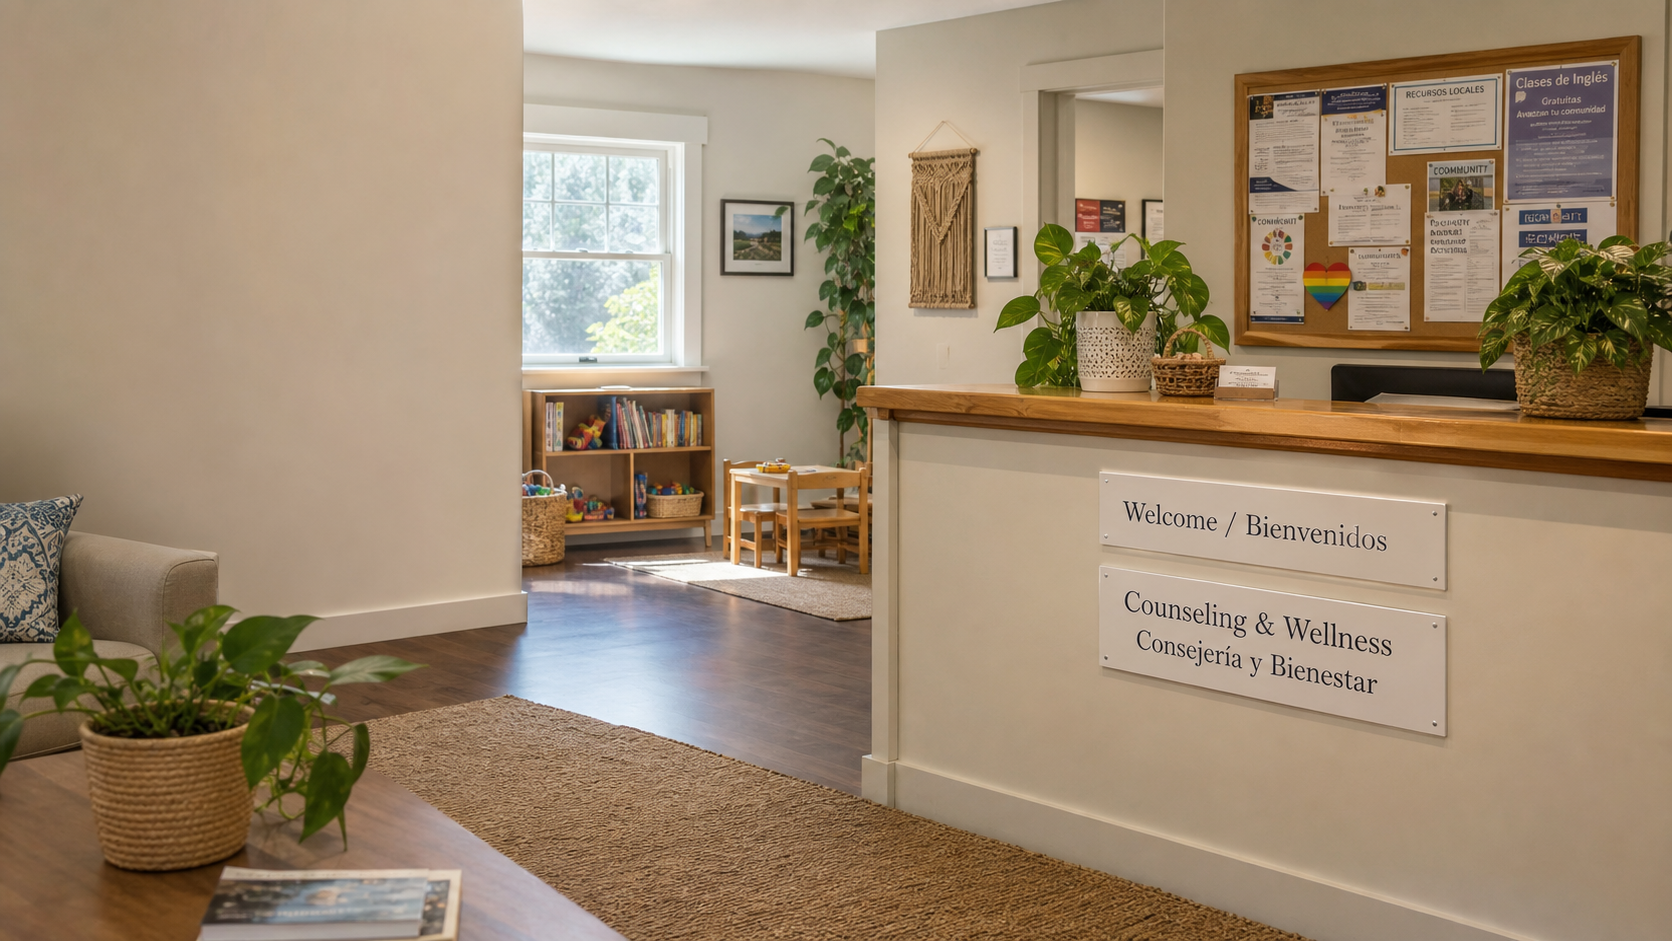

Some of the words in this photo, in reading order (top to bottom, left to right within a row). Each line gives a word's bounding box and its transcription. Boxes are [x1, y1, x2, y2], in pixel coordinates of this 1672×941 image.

[1406, 88, 1447, 99] RECURSOS
[1449, 85, 1485, 95] LOCALES
[1516, 77, 1552, 89] Clases
[1555, 74, 1570, 86] de
[1573, 70, 1608, 87] Inglés
[1541, 95, 1582, 105] Gratuitas
[1122, 500, 1218, 532] Welcome
[1224, 511, 1237, 538] /
[1246, 513, 1388, 552] Bienvenidos
[1124, 590, 1247, 639] Counseling
[1255, 612, 1275, 637] &
[1283, 615, 1393, 657] Wellness
[1136, 629, 1243, 668] Consejería
[1250, 656, 1263, 677] y
[1270, 653, 1378, 695] Bienestar
